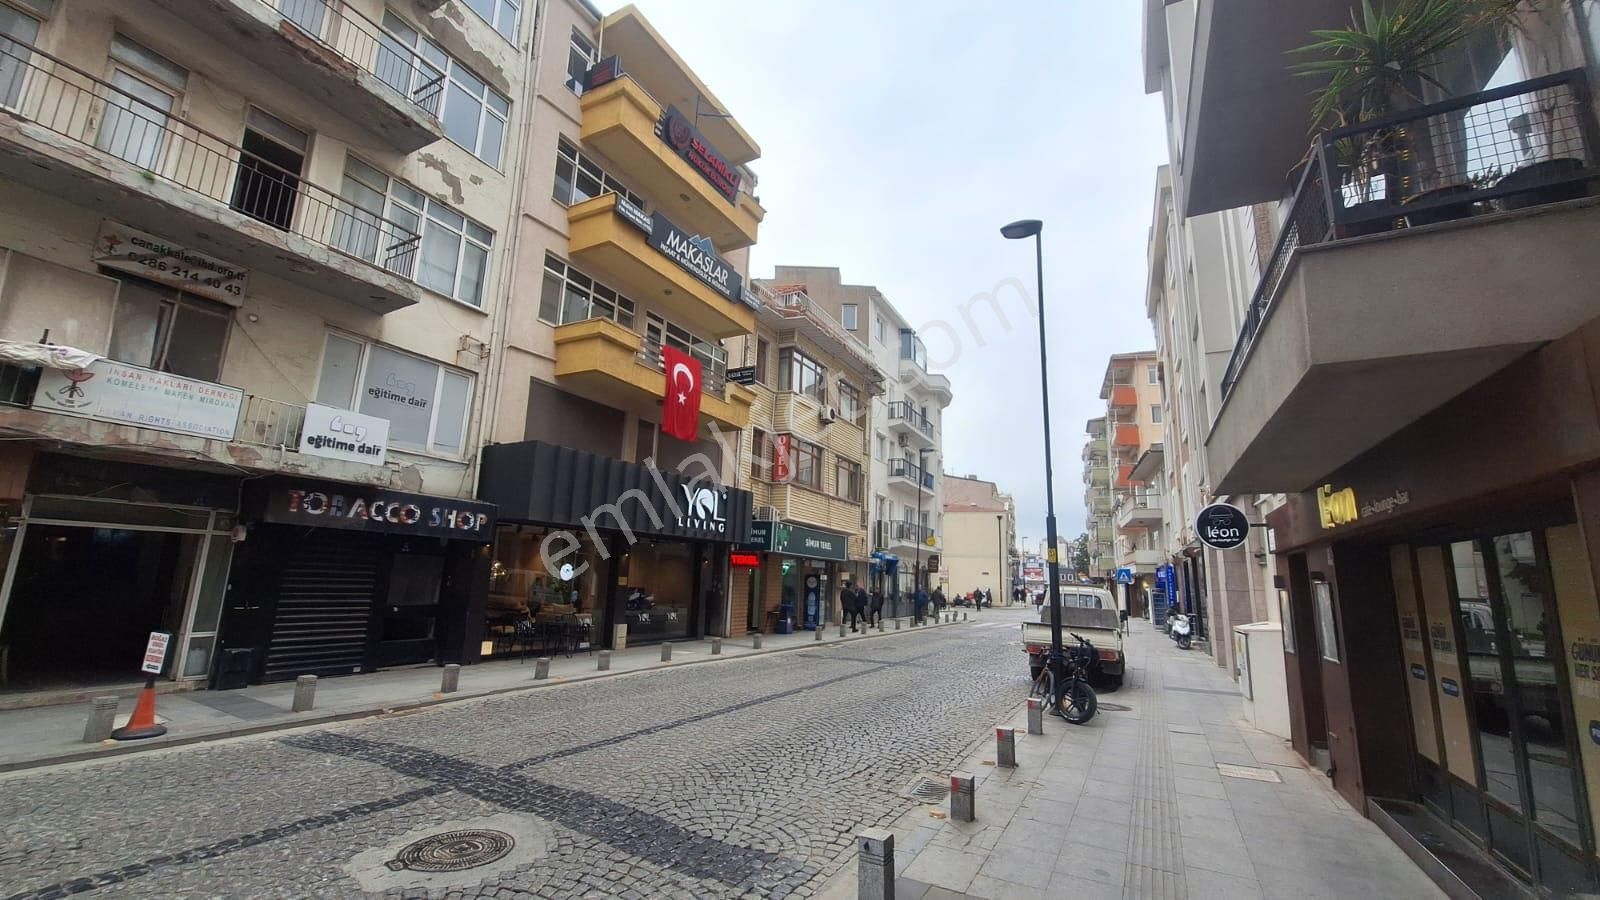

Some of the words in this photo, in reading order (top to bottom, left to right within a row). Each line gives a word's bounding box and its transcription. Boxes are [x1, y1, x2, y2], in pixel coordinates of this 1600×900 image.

[666, 230, 729, 287] MAKASLAR
[171, 265, 200, 282] 214
[203, 278, 221, 289] 40
[224, 284, 242, 297] 43
[150, 376, 193, 392] HAKLARI
[368, 387, 406, 403] eğitime
[408, 396, 428, 409] dair
[138, 412, 171, 427] RIGHTS
[307, 434, 356, 452] eğitime
[357, 442, 382, 457] dair
[776, 435, 787, 477] OTEL
[287, 489, 421, 525] TOBACCO
[428, 507, 488, 532] SHOP
[677, 516, 726, 533] LIVING
[1207, 525, 1240, 538] léon
